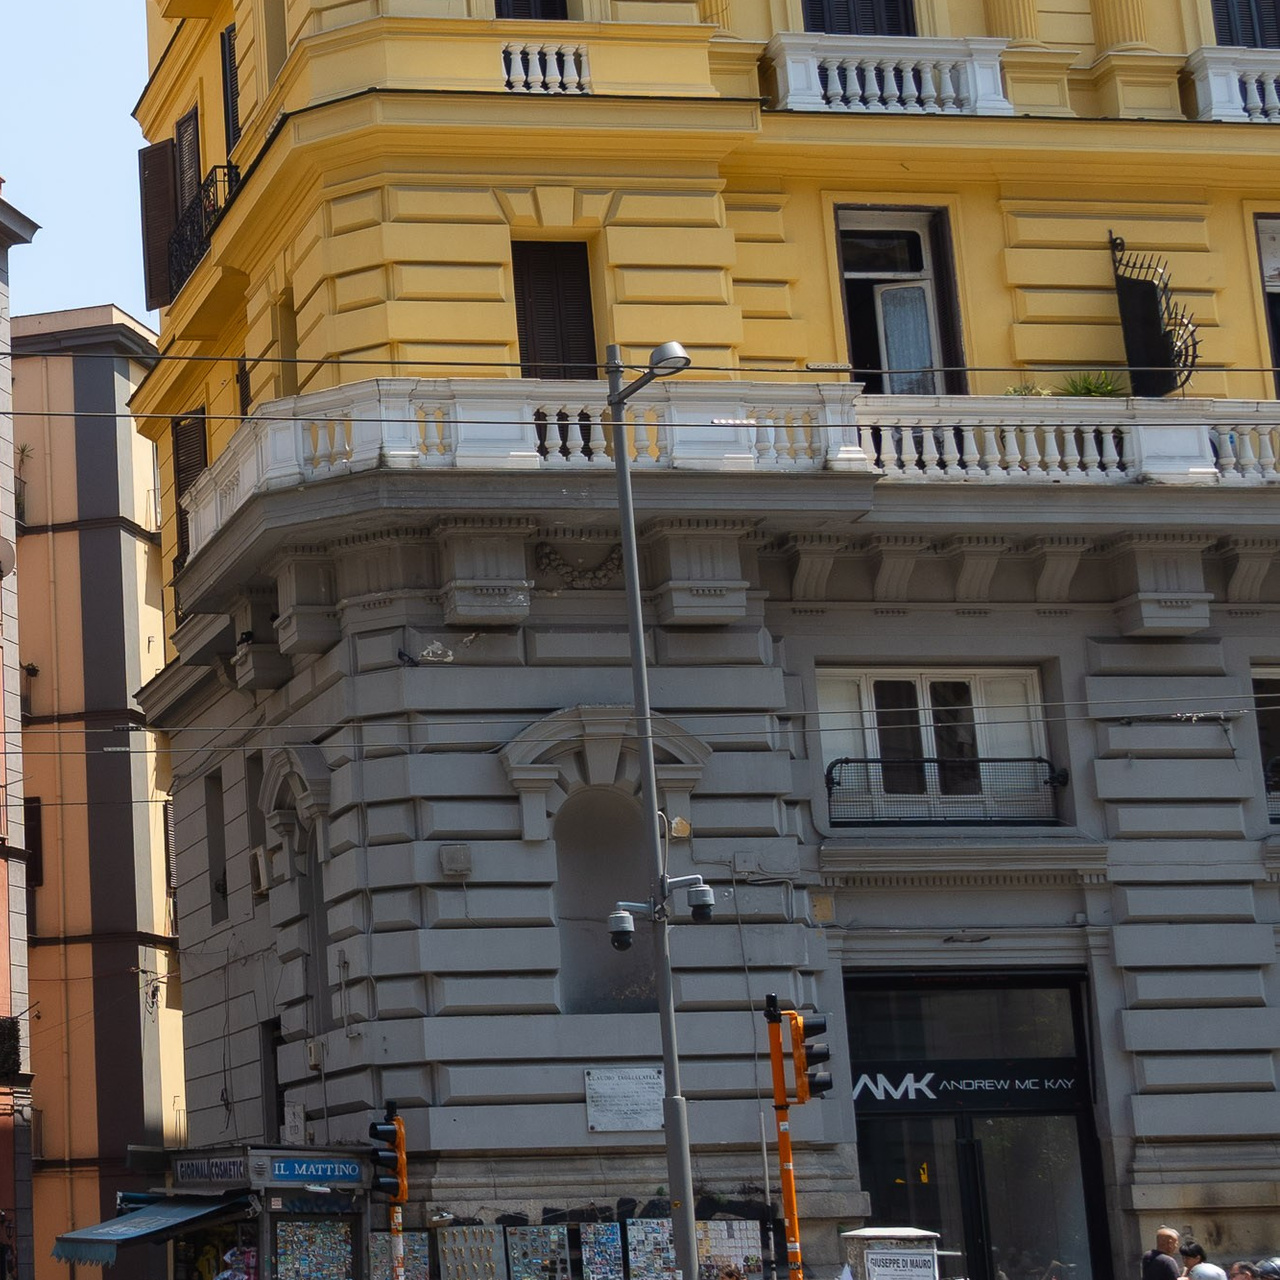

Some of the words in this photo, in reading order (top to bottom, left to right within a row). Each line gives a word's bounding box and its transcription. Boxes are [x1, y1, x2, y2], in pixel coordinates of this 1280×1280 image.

[852, 1072, 937, 1100] AMK
[939, 1079, 1010, 1090] ANDREW
[1015, 1079, 1040, 1090] MC
[1044, 1078, 1075, 1089] KAY
[274, 1163, 289, 1175] IL
[294, 1163, 359, 1176] MATTINO
[870, 1257, 901, 1269] GIUSEPPE
[901, 1258, 909, 1269] DI
[909, 1259, 932, 1270] MAURO
